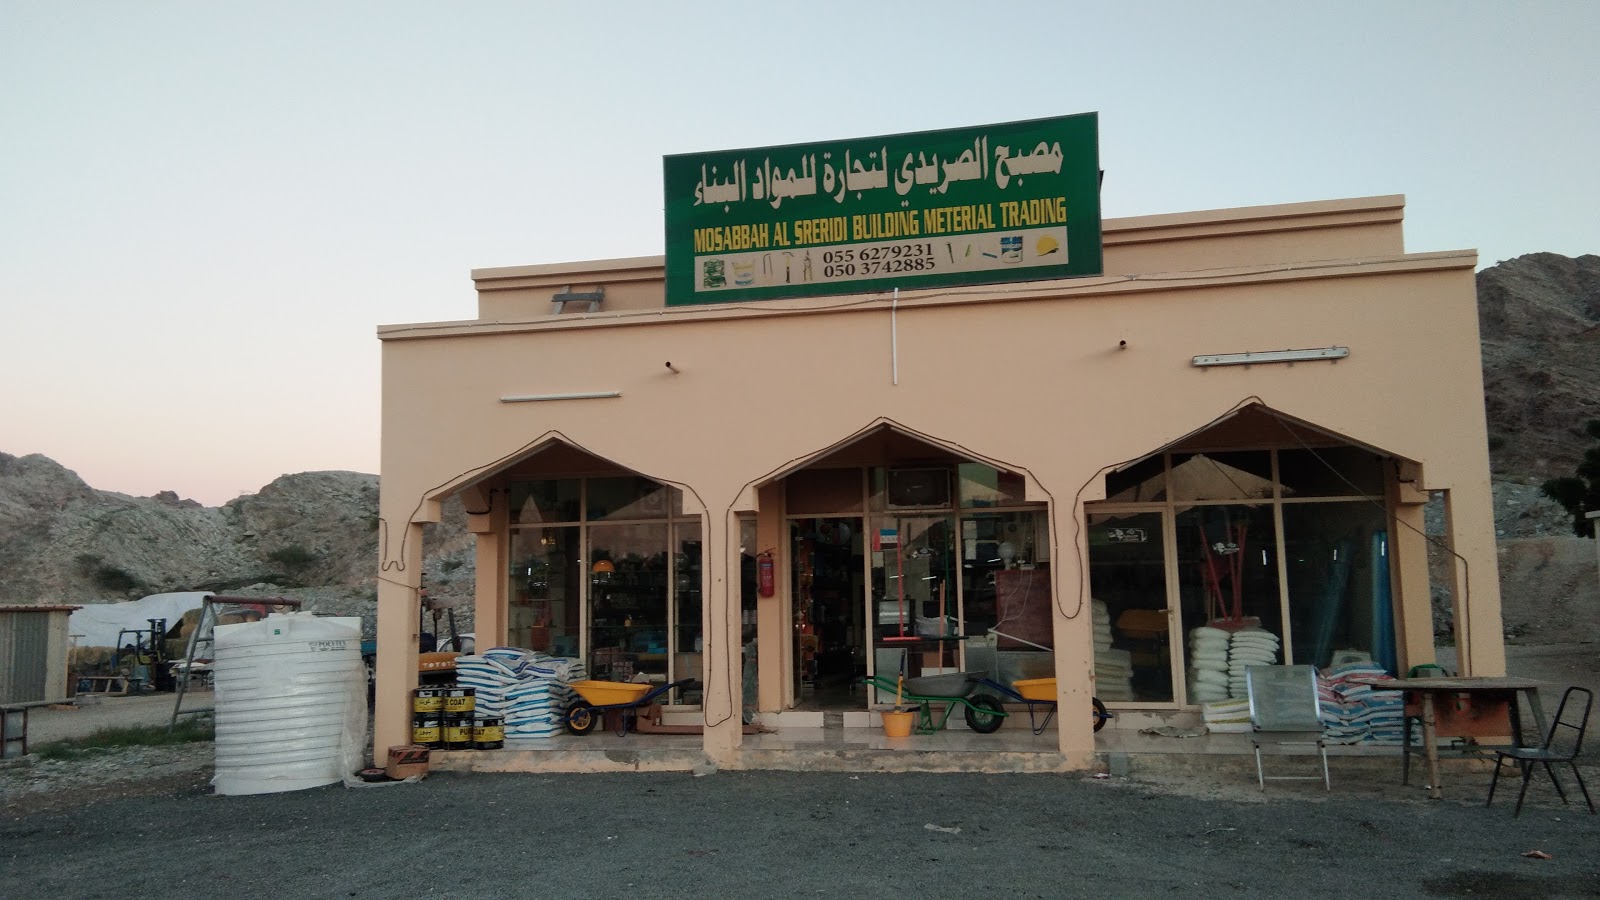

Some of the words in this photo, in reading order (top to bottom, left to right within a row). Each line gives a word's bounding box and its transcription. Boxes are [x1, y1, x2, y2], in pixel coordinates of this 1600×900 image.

[693, 159, 747, 213] البناء
[752, 153, 817, 209] للمواد
[823, 145, 888, 204] لتجارة
[894, 134, 989, 207] الصريدي
[995, 141, 1064, 189] مصبح
[694, 223, 769, 253] MOSABBAH
[772, 221, 791, 247] AL
[794, 216, 848, 245] SRERIDI
[852, 210, 920, 240] BUILDING
[923, 203, 996, 234] METERIAL
[999, 196, 1067, 228] TRADING
[823, 249, 855, 264] 055
[859, 243, 933, 262] 6279231
[824, 263, 856, 278] 050
[860, 257, 936, 275] 3742885
[450, 698, 466, 706] COAT
